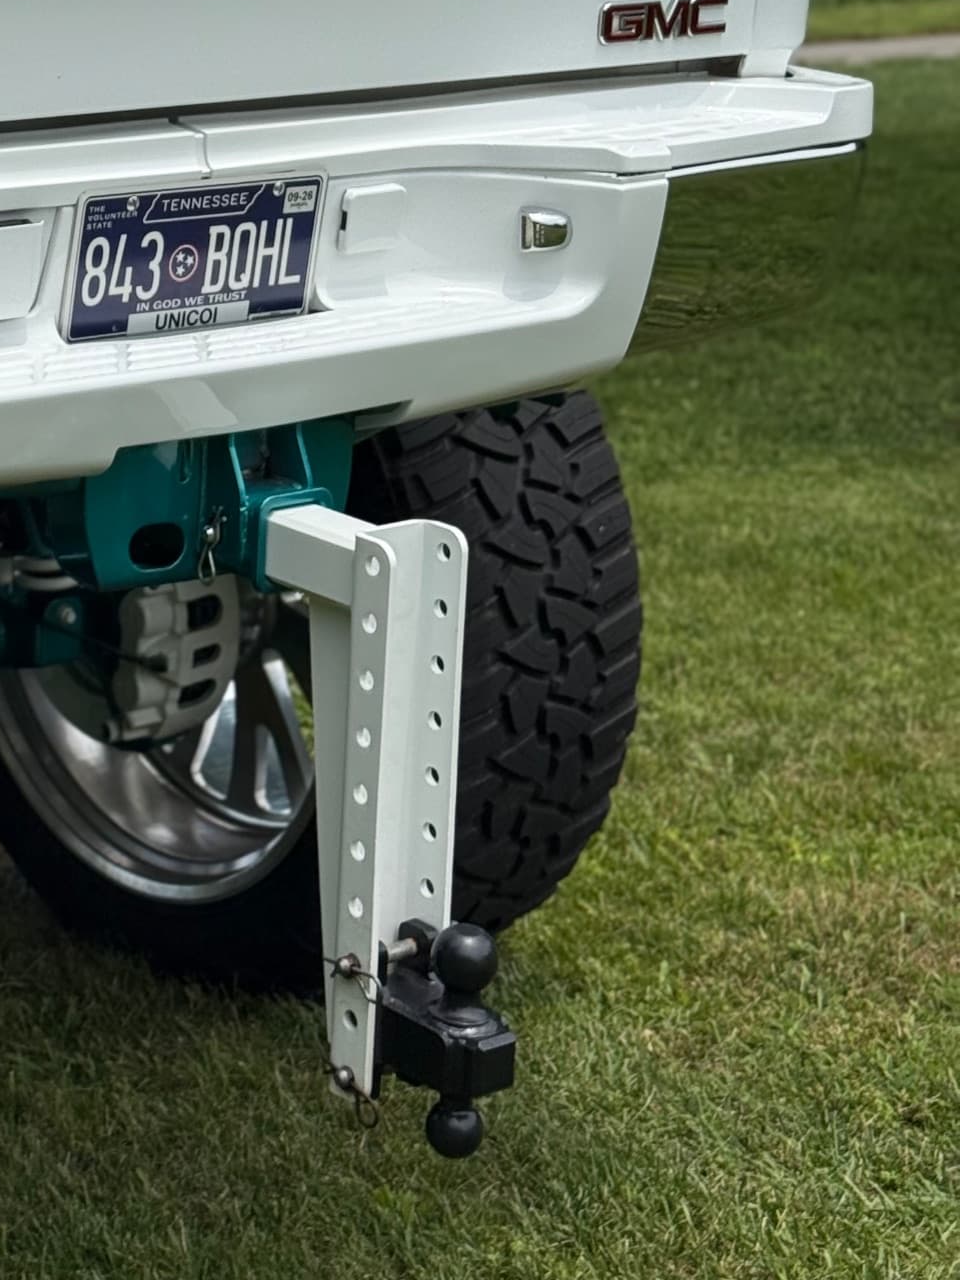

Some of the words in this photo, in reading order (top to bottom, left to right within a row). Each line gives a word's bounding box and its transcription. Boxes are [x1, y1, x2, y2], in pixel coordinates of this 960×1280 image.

[90, 205, 105, 213] THE
[162, 191, 250, 212] TENNESSEE
[86, 221, 112, 230] STATE
[88, 210, 138, 221] VOLUNTEER
[81, 230, 165, 307] 843
[201, 217, 301, 294] BQHL
[136, 302, 150, 312] IN
[153, 299, 181, 310] GOD
[185, 296, 204, 307] WE
[208, 290, 248, 303] TRUST
[155, 307, 218, 330] UNICOI
